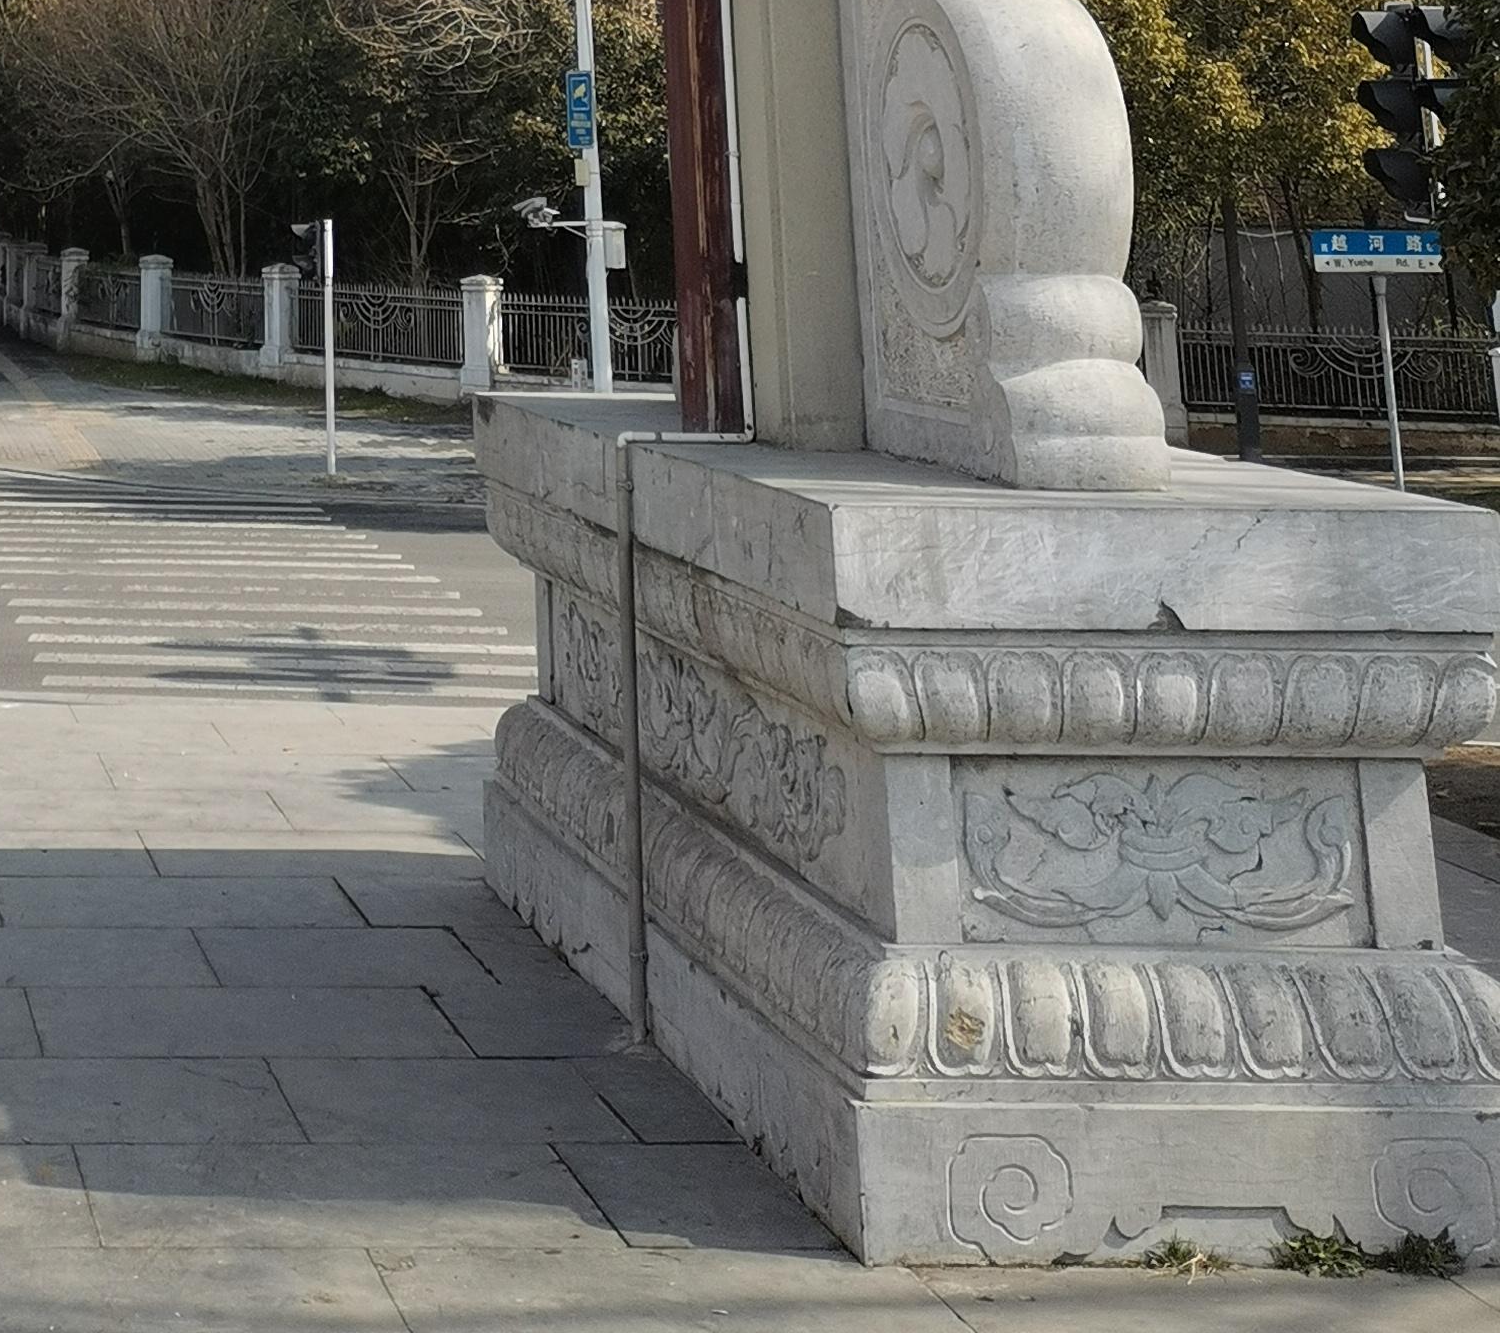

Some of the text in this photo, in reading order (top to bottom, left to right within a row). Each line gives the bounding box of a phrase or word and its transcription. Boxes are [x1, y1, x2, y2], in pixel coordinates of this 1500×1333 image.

[1331, 234, 1423, 253] 越河路
[1348, 258, 1374, 268] Yuehe
[1395, 258, 1410, 269] Rd.
